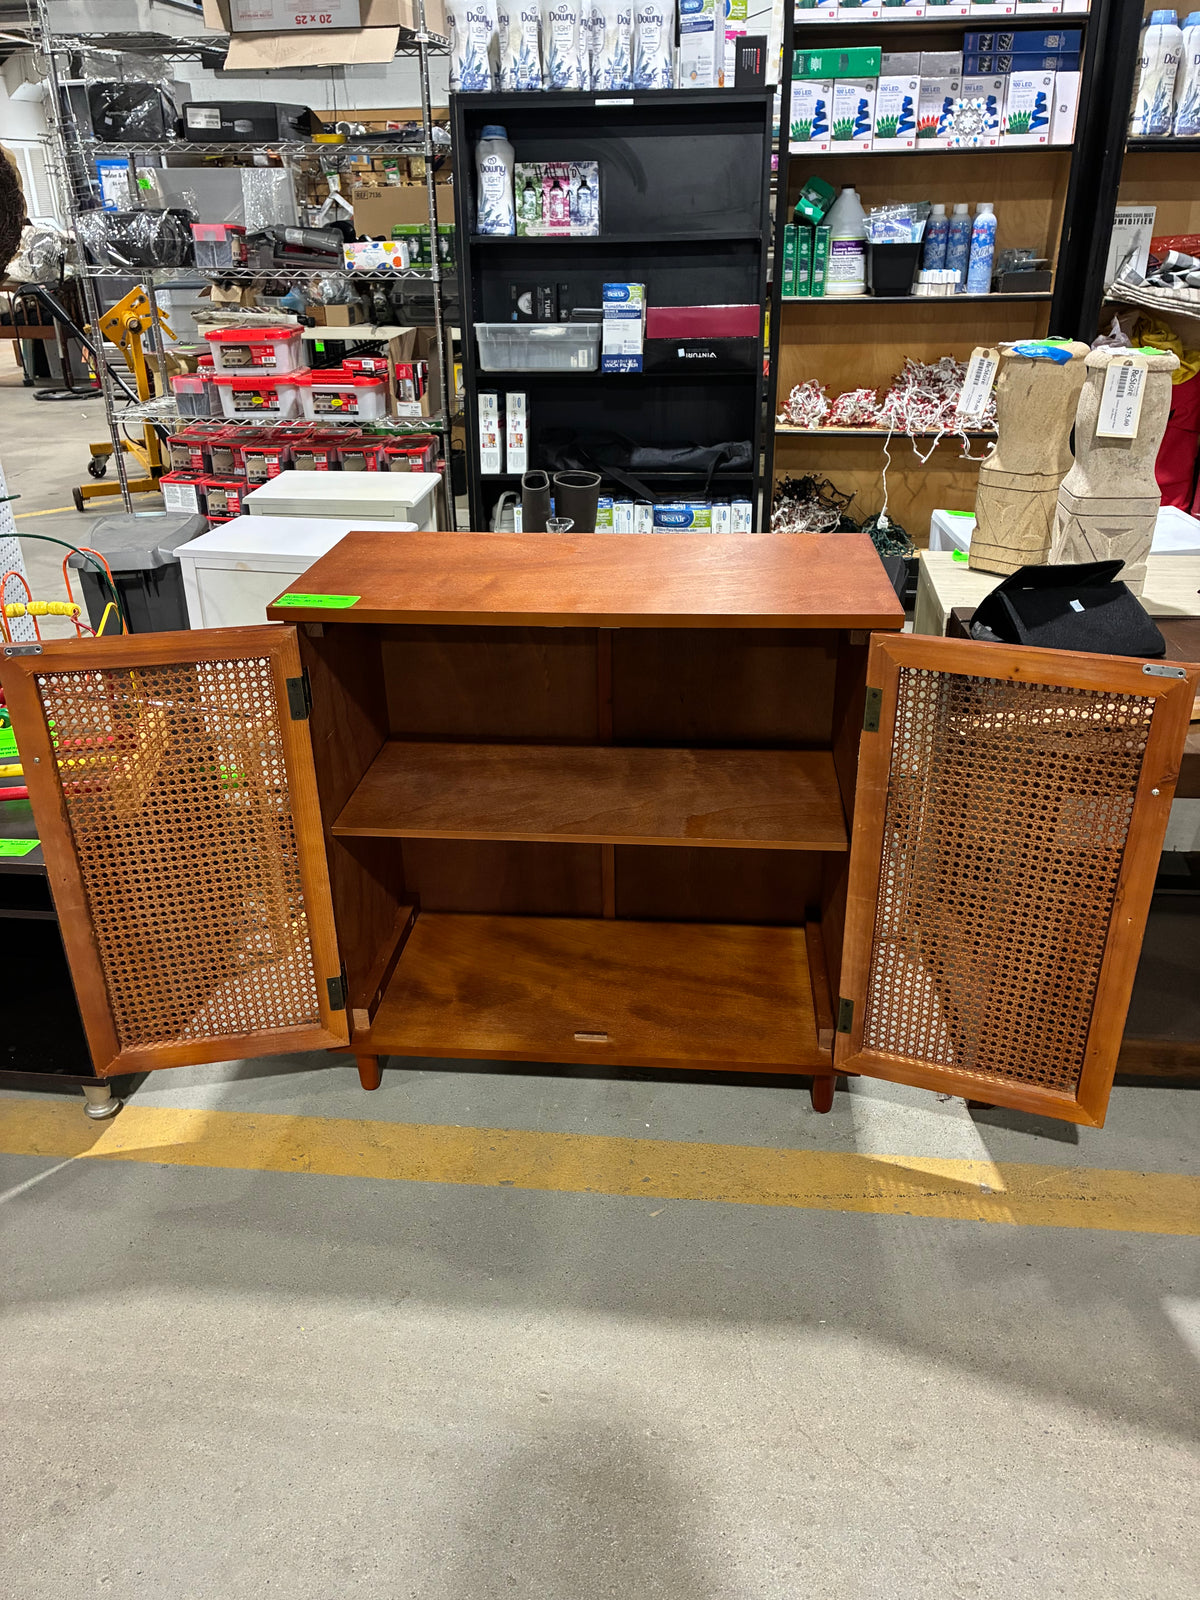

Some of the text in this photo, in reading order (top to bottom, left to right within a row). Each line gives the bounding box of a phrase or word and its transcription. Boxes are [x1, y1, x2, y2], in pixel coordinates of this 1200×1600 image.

[295, 15, 308, 24] 25
[320, 14, 332, 24] 20
[549, 11, 576, 24] Downy
[637, 14, 663, 27] Downy
[480, 163, 507, 177] Downy
[1127, 369, 1140, 397] ReStore
[1123, 406, 1133, 427] $75.00
[661, 514, 686, 523] BestAir
